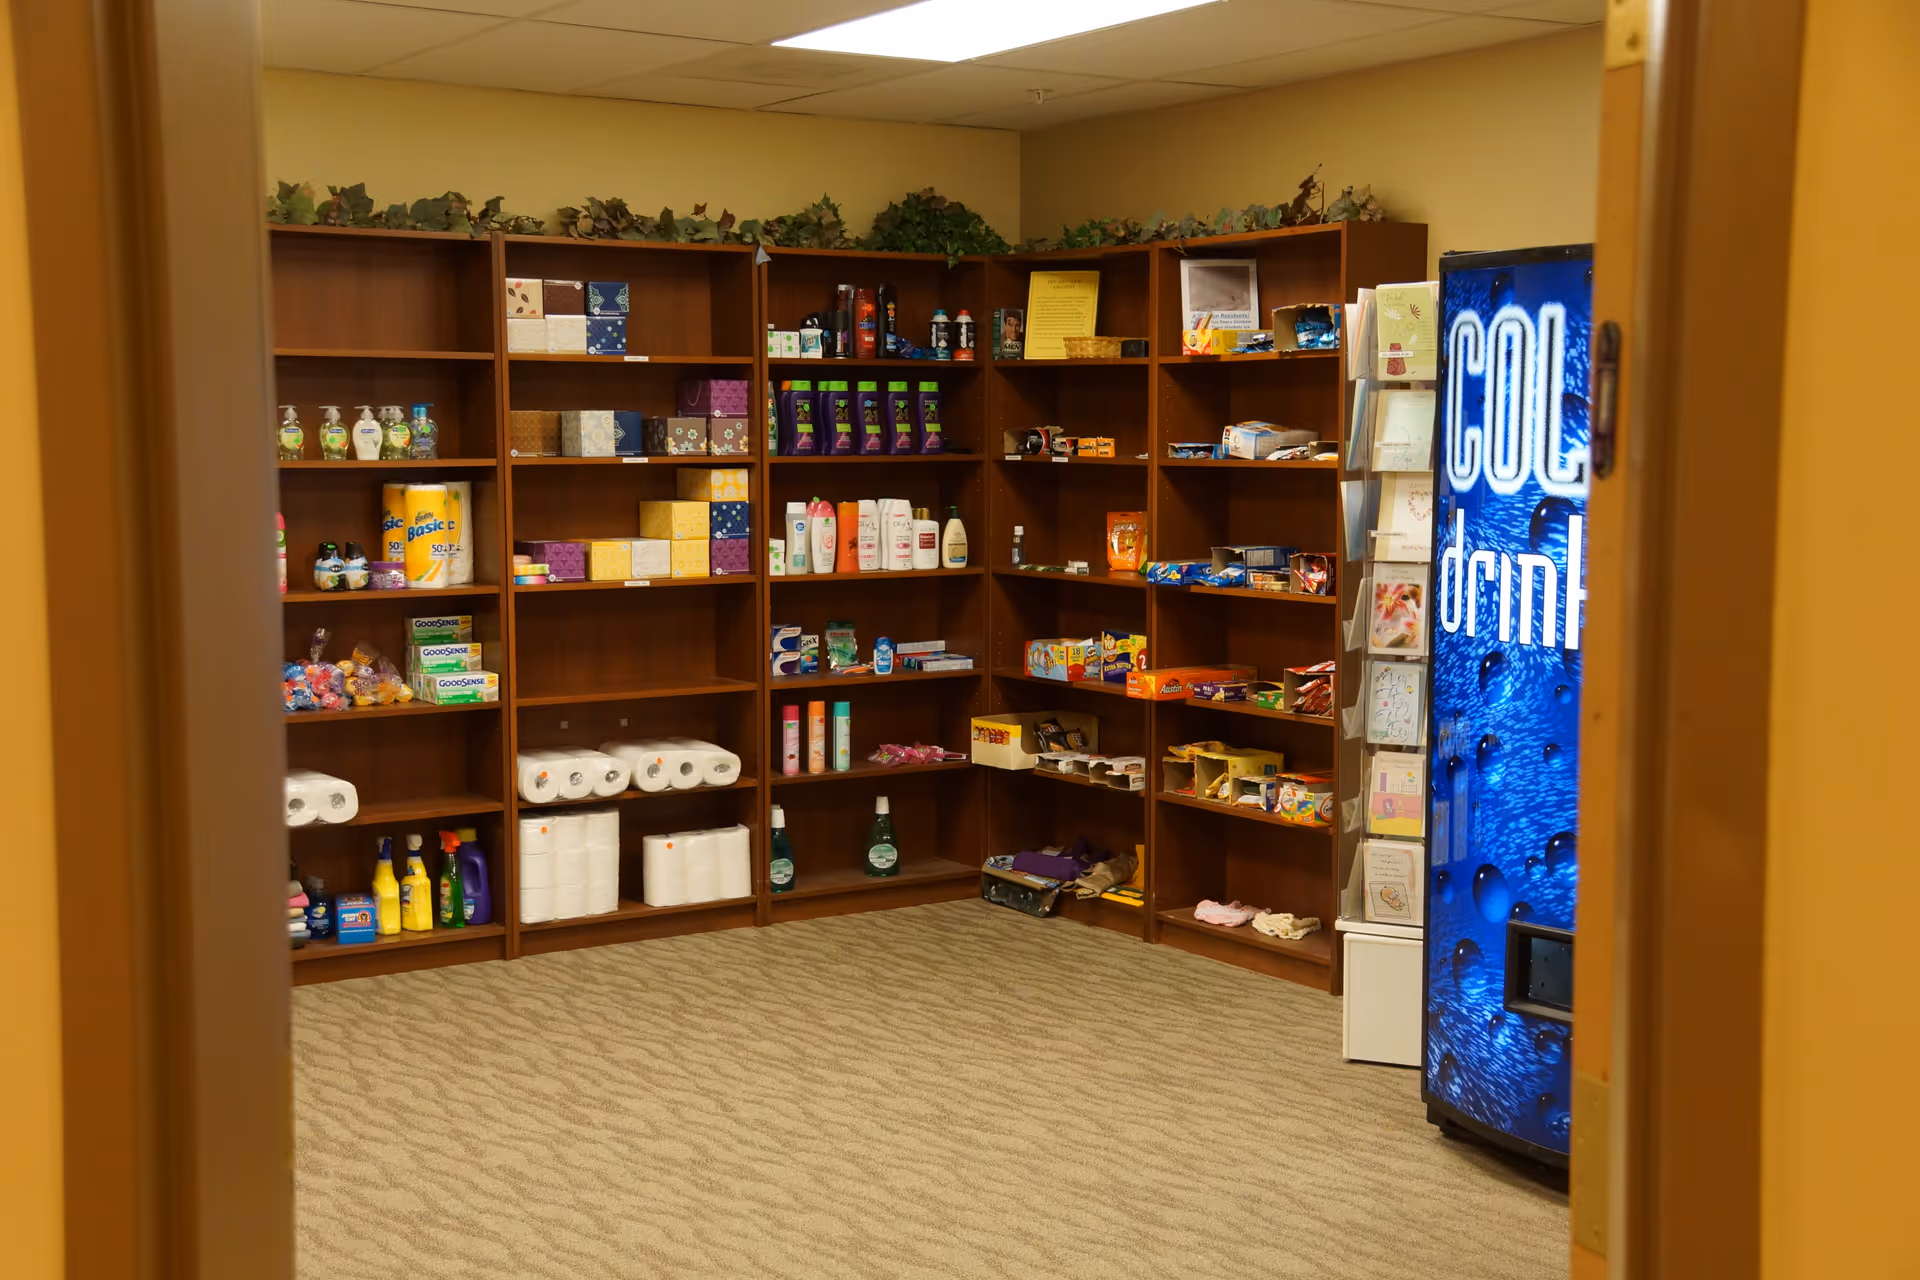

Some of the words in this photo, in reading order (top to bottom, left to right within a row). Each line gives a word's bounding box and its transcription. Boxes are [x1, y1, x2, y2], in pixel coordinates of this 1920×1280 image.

[1447, 303, 1590, 496] COL
[382, 516, 404, 531] sic
[407, 518, 445, 543] Basic
[1071, 647, 1081, 656] 18
[1160, 684, 1183, 694] Austin
